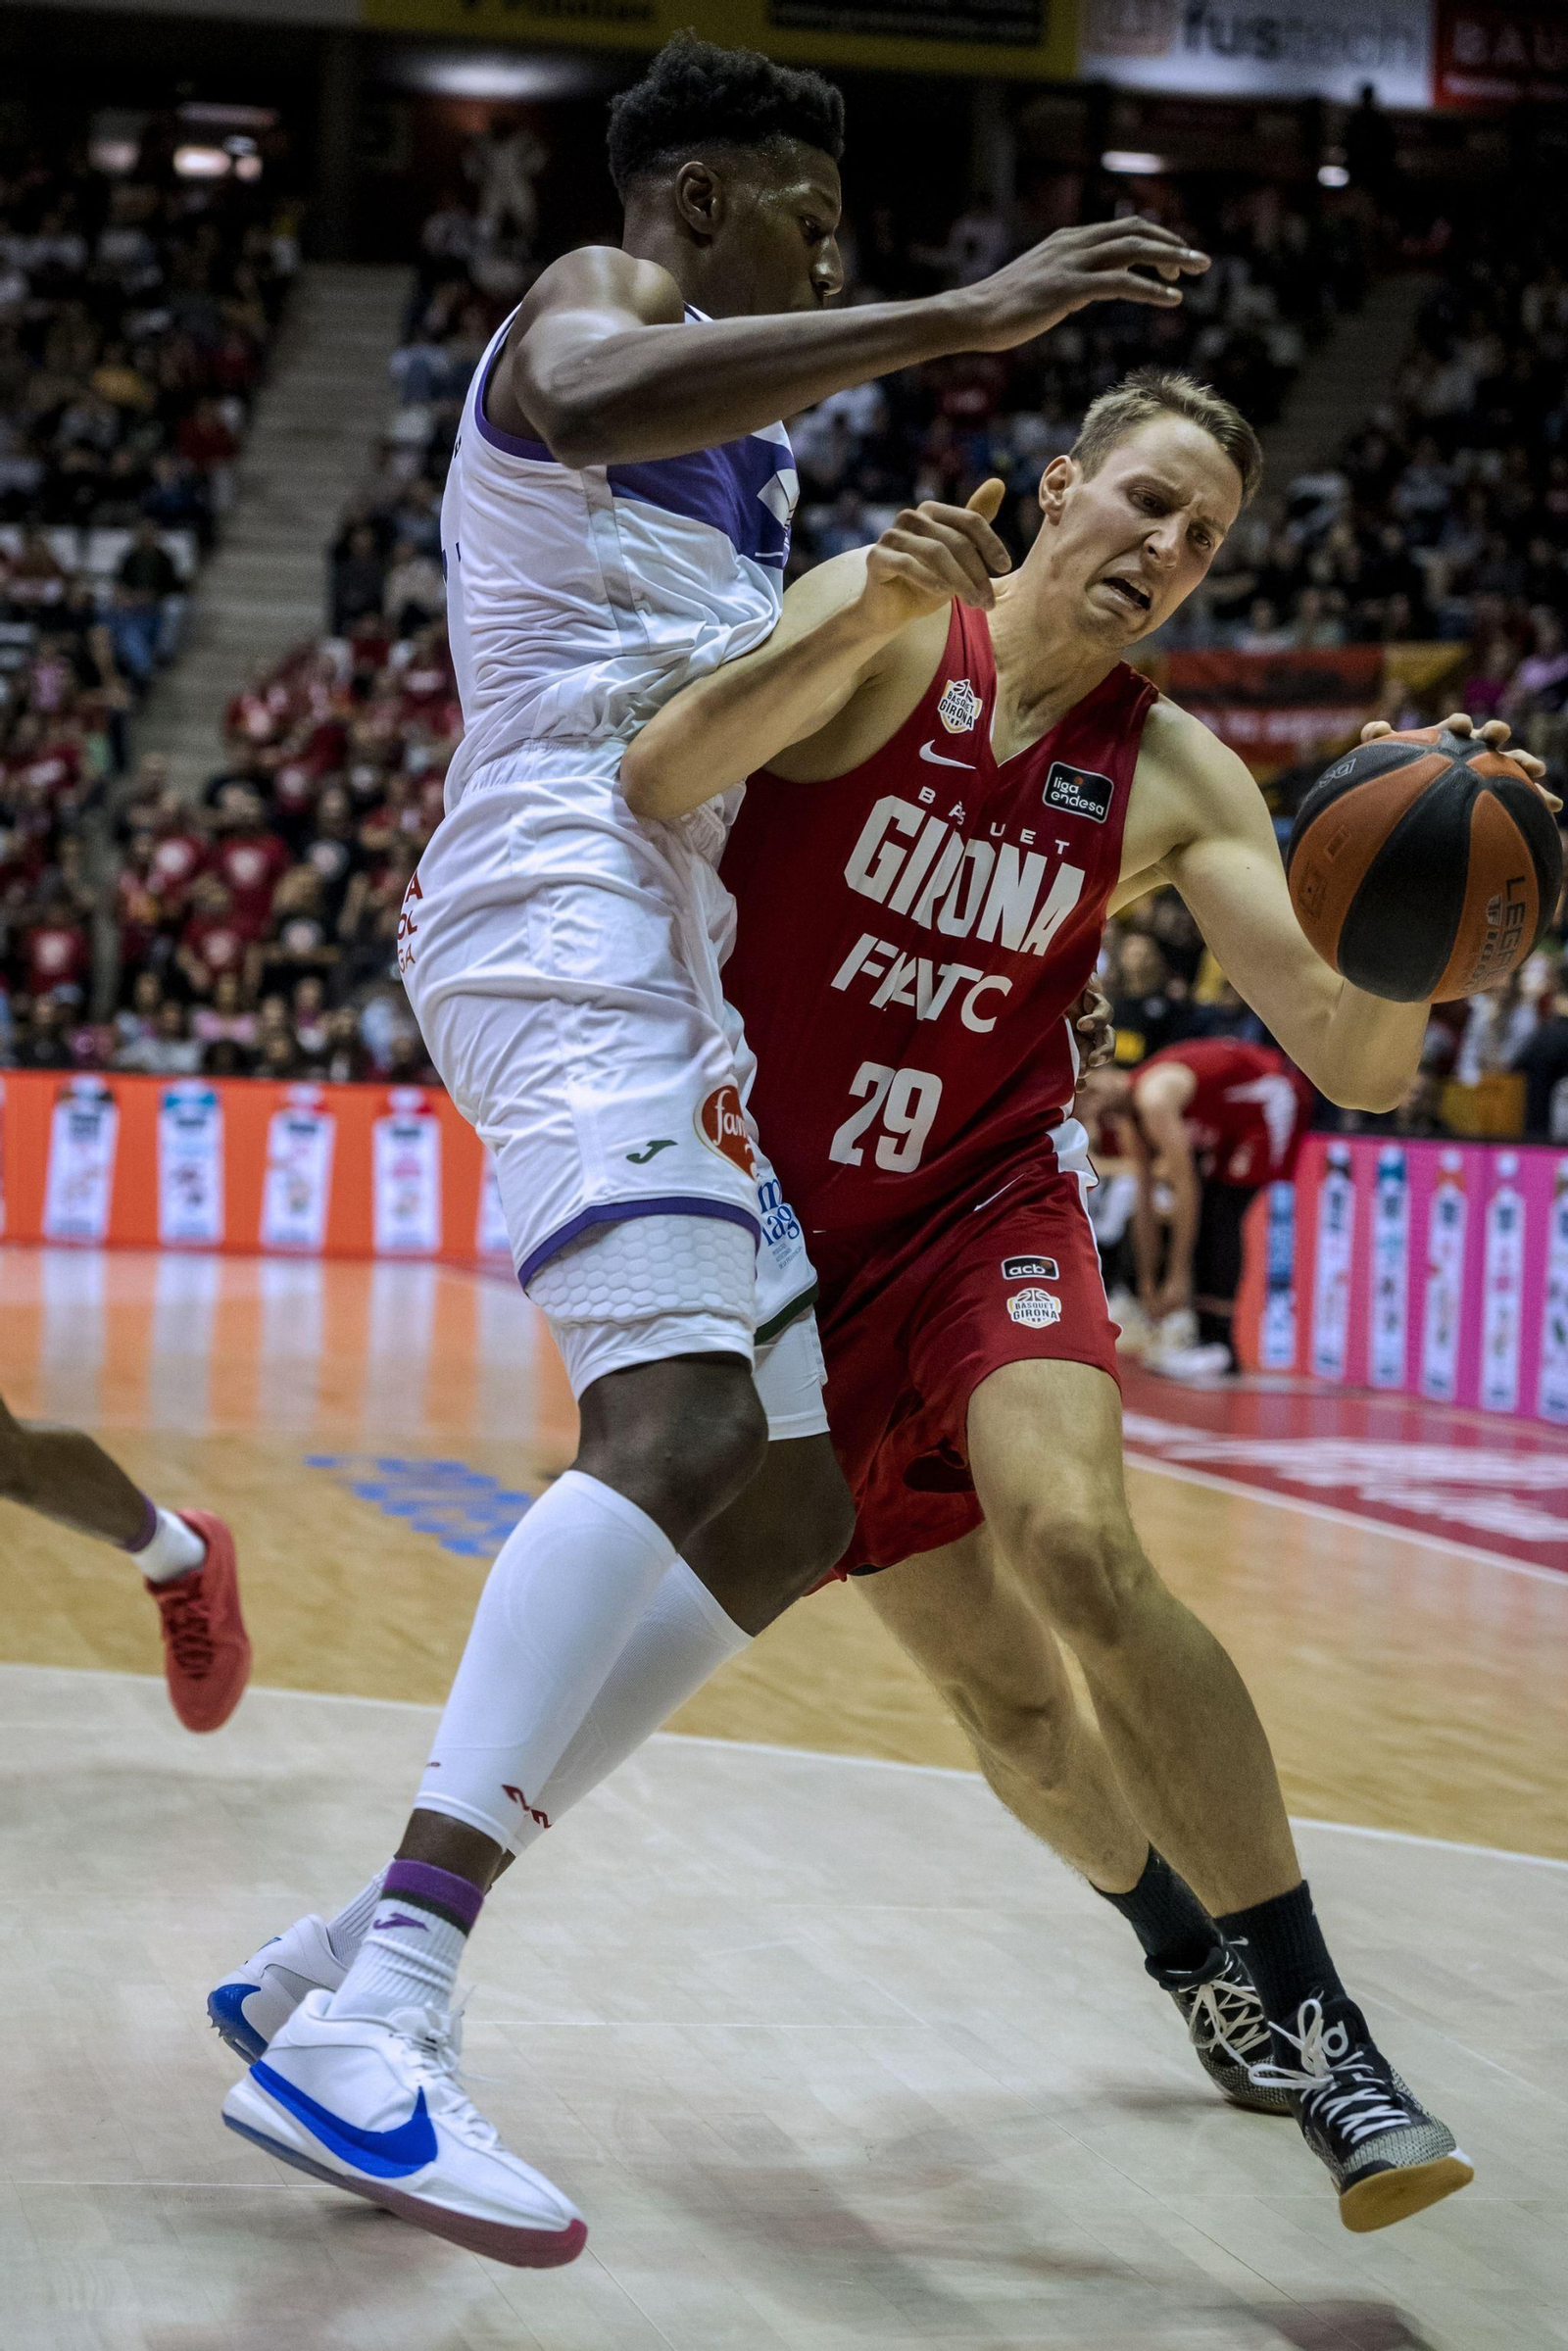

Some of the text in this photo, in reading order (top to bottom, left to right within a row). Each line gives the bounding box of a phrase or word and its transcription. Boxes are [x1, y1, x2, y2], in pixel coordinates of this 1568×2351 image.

[939, 699, 973, 728] GIRONA
[948, 691, 974, 713] BASQET
[1054, 777, 1079, 794] liga
[1051, 791, 1104, 815] endesa
[918, 786, 1070, 855] BÀSUET
[844, 795, 1086, 956] GIRONA
[830, 933, 1013, 1034] FIATC
[828, 1060, 943, 1173] 29
[1008, 1263, 1046, 1275] acb
[1013, 1308, 1057, 1320] GIRONA
[1015, 1301, 1054, 1310] BASQUET
